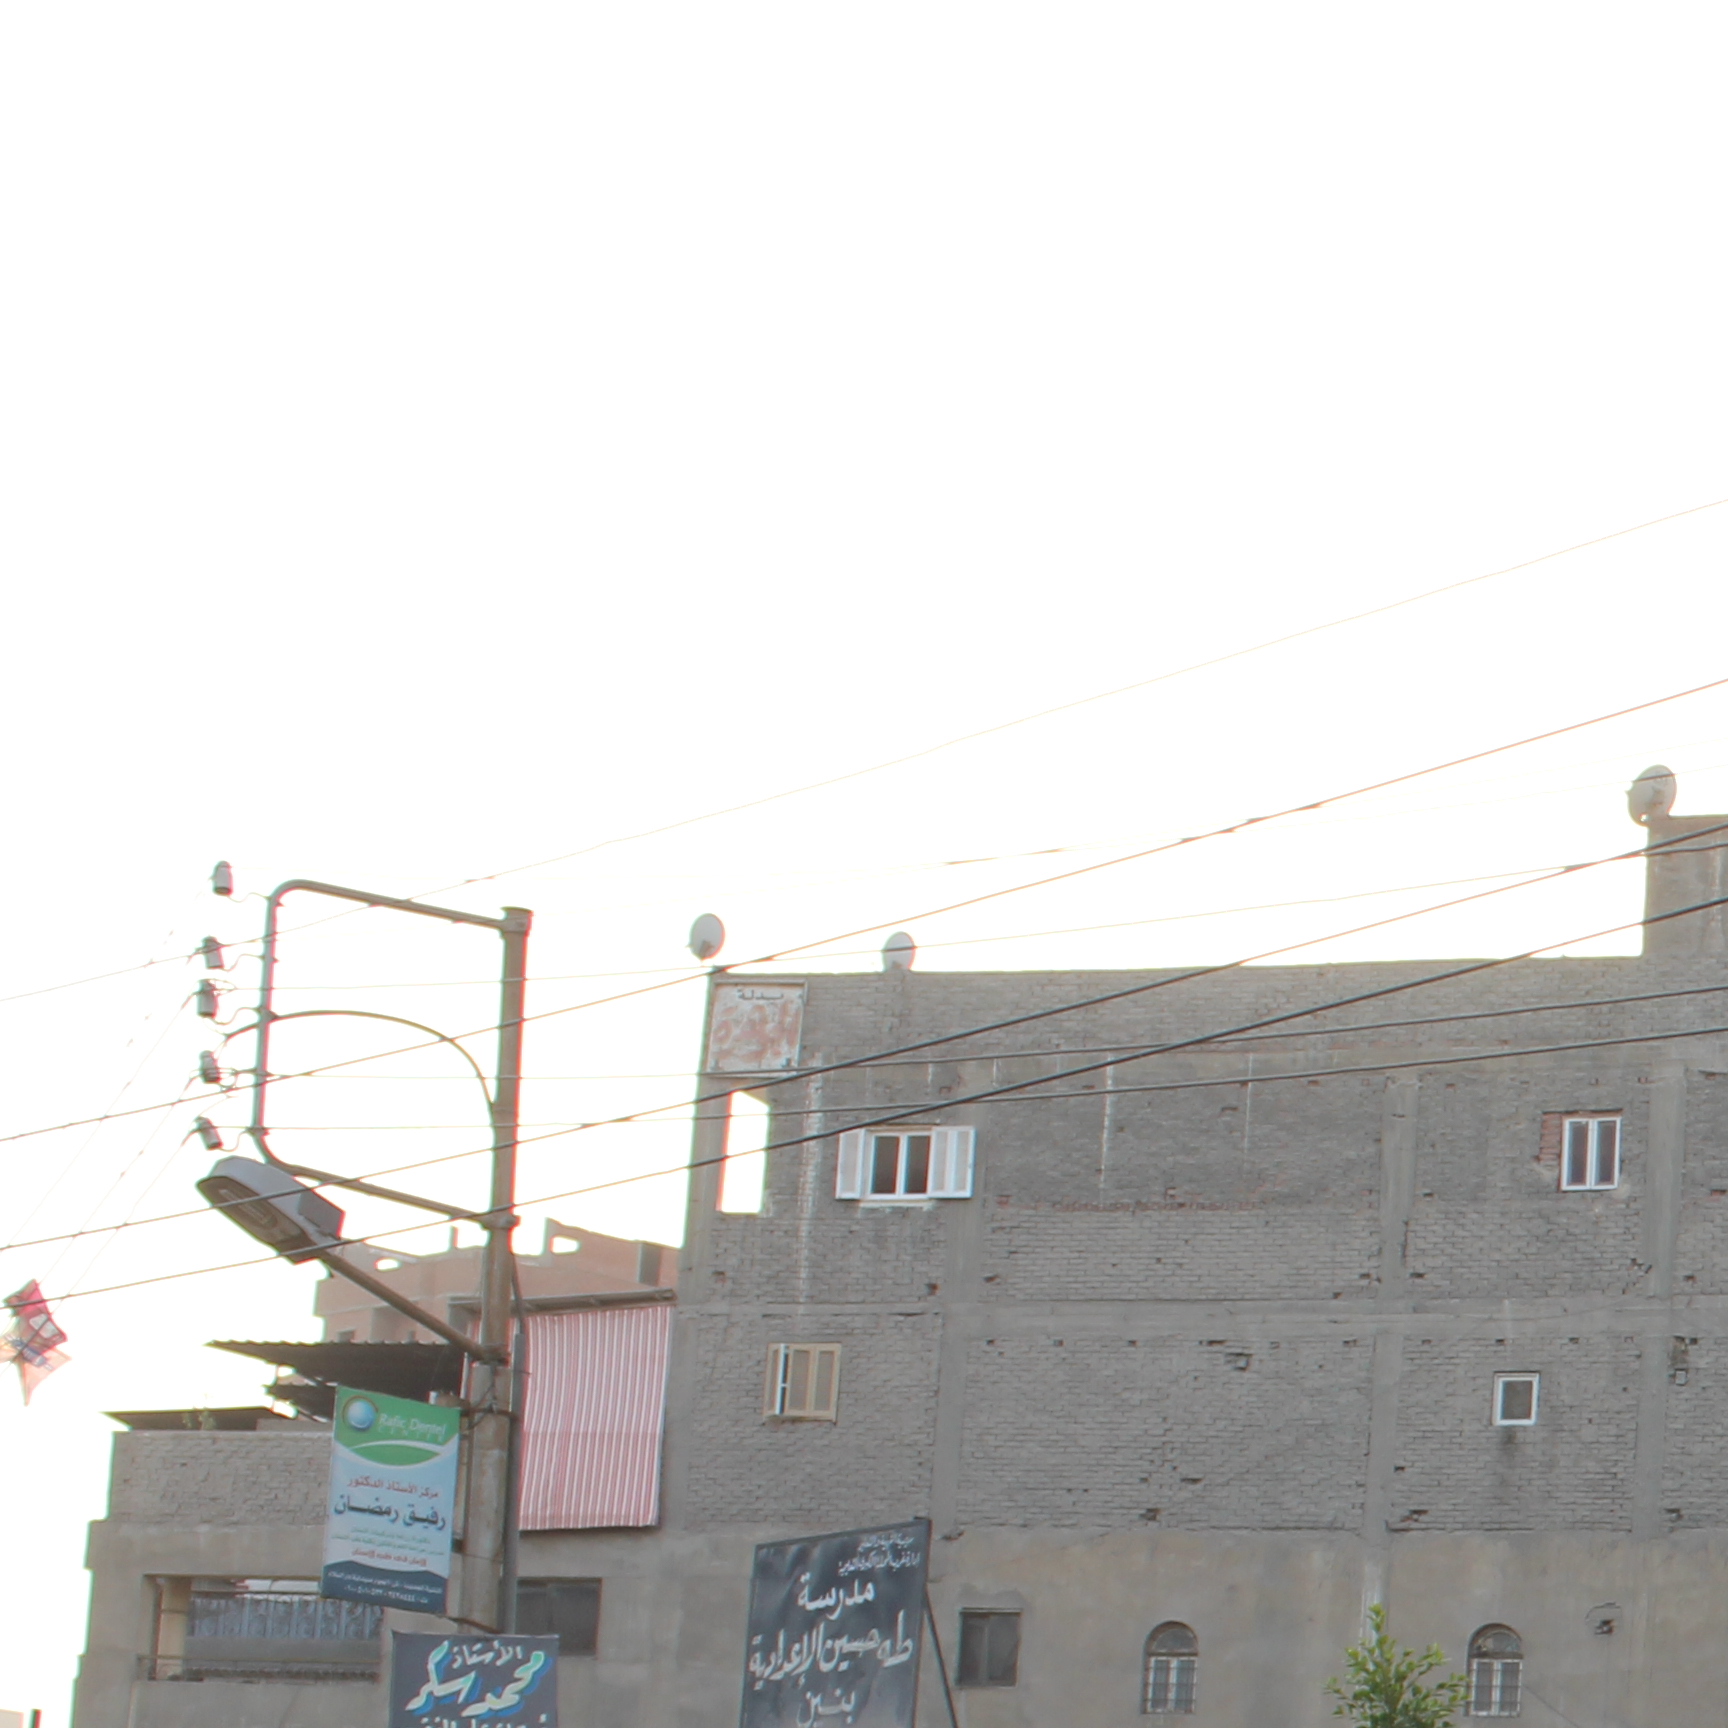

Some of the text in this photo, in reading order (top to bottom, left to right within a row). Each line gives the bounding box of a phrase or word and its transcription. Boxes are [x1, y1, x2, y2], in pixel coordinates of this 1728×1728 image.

[333, 1494, 446, 1532] رفيق رمضان
[797, 1571, 876, 1621] مدرسة
[451, 1639, 524, 1669] الأستاذ
[748, 1609, 914, 1691] طه حسين الإعدادية
[460, 1650, 546, 1718] محمد
